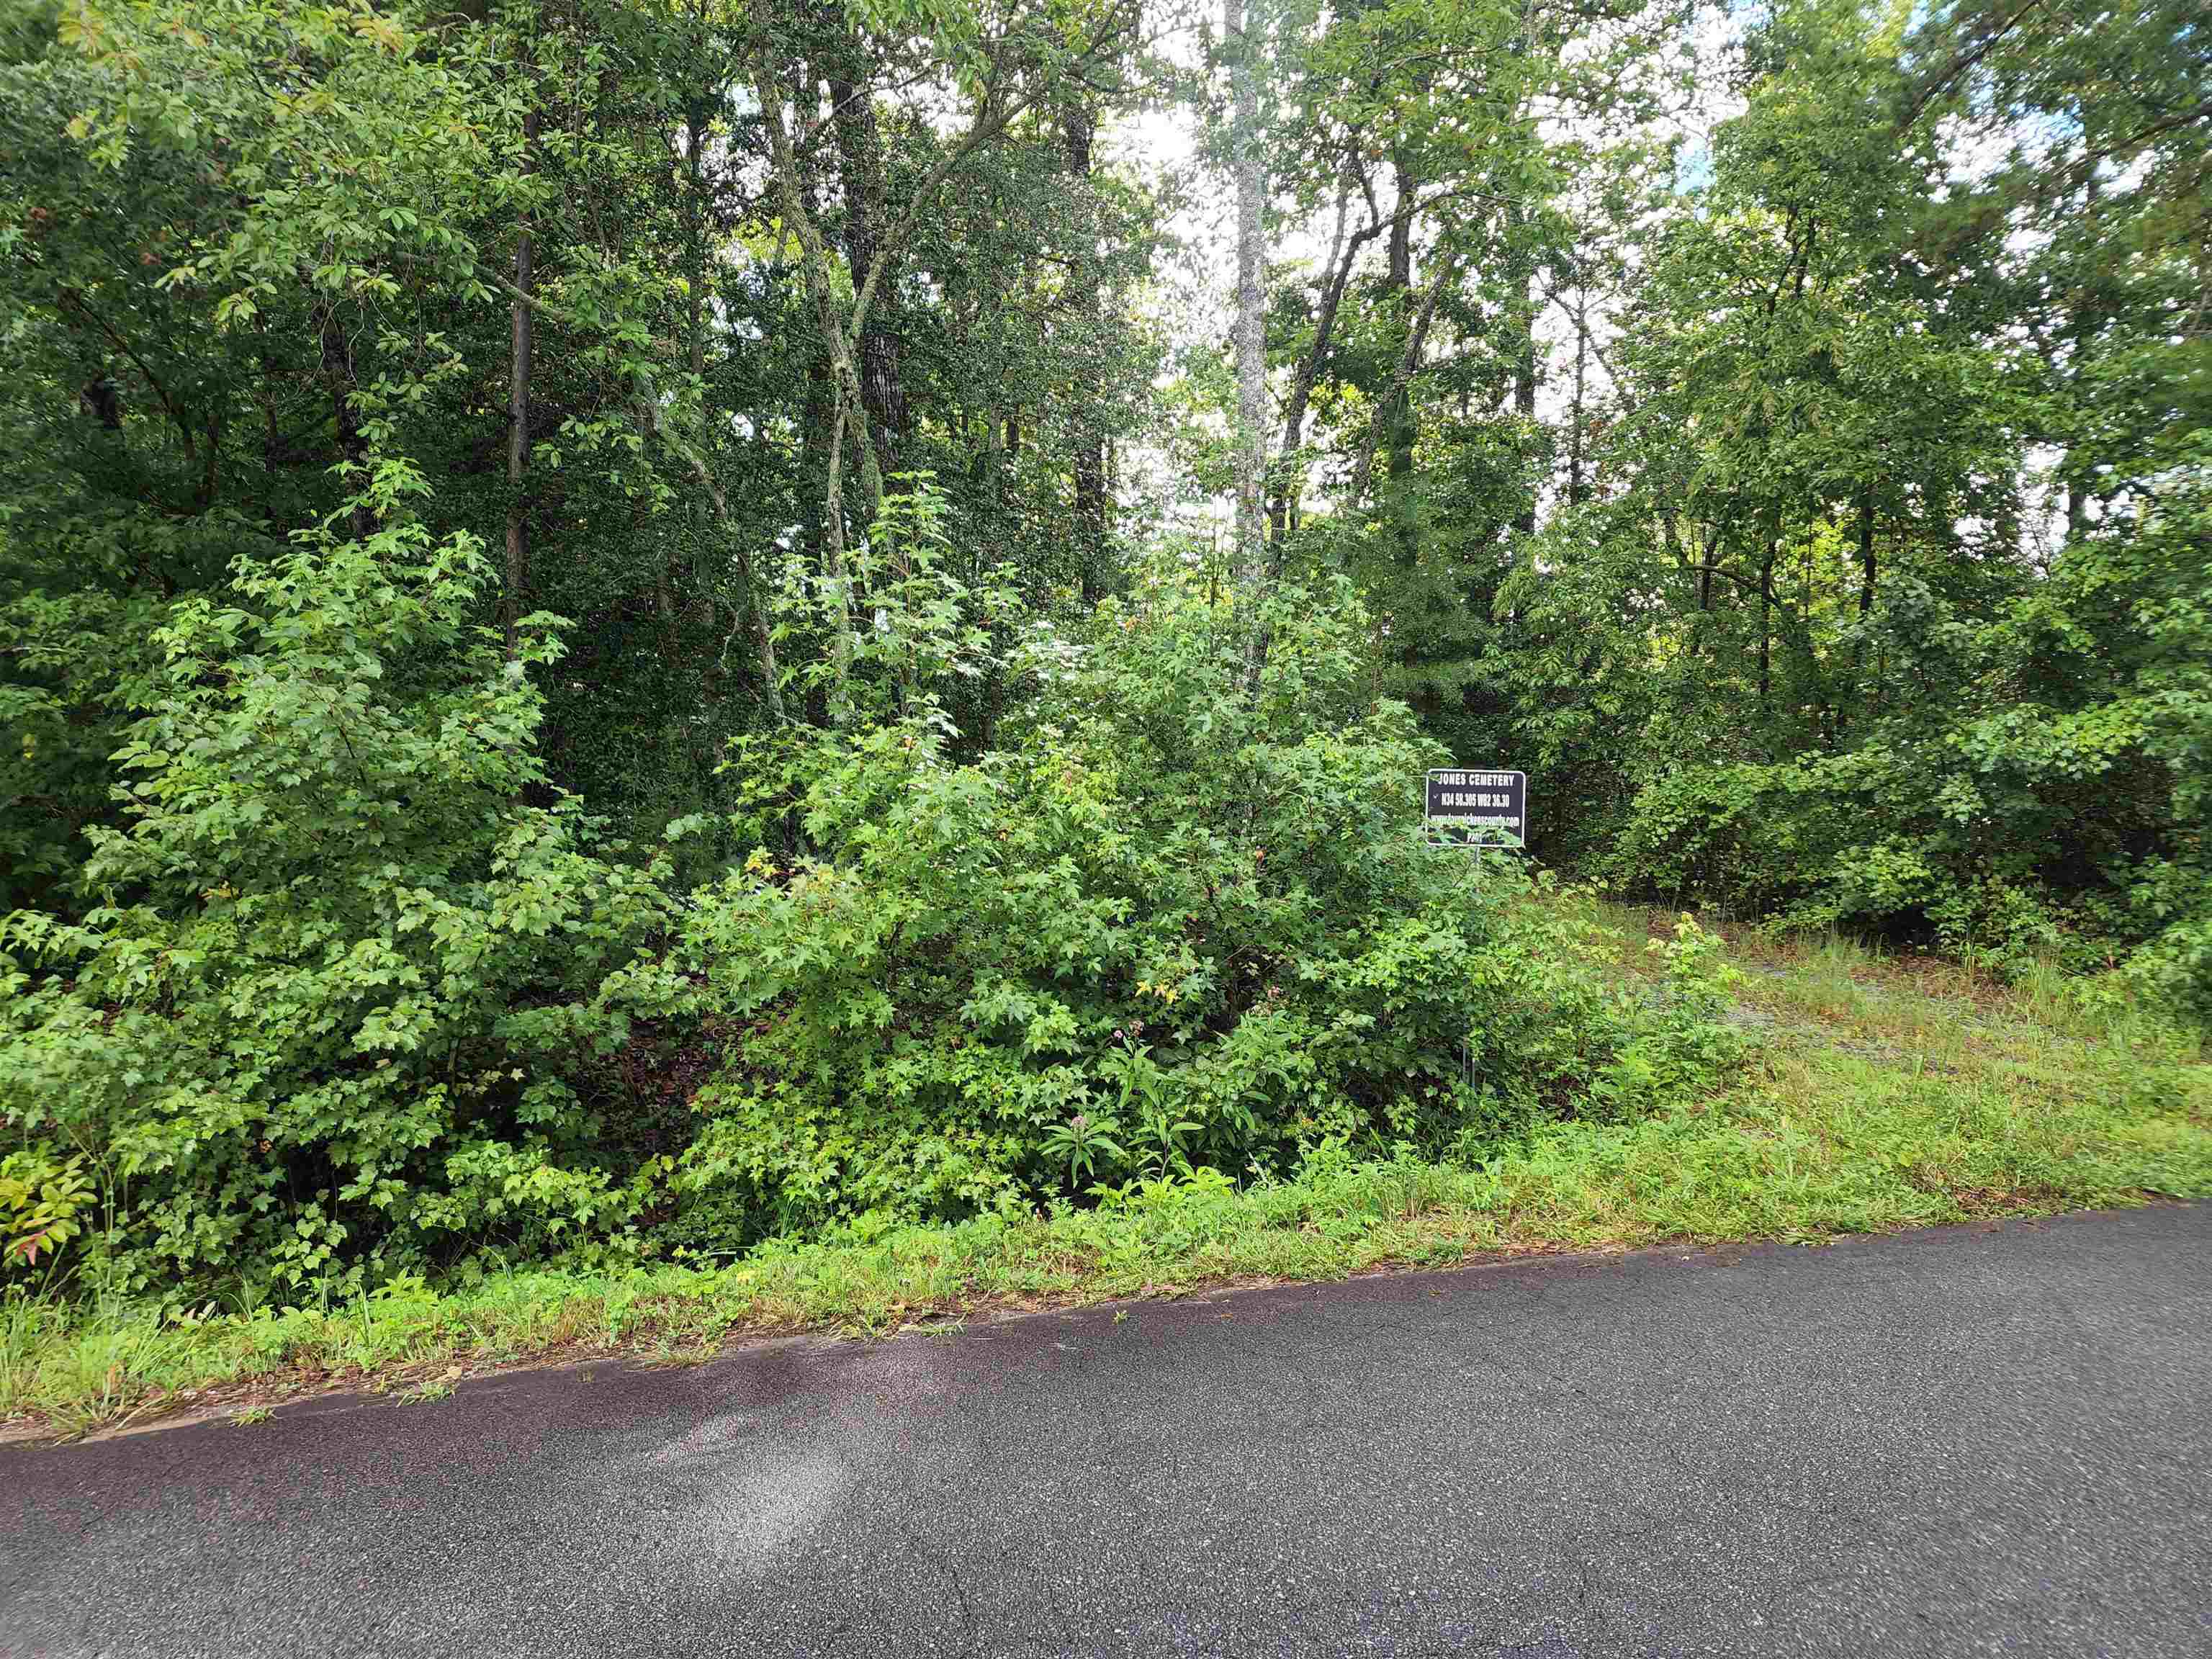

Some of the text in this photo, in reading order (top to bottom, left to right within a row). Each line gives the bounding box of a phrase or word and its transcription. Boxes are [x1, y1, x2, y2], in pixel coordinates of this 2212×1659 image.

[1439, 773, 1515, 786] JONES CEMETERY
[1442, 793, 1454, 806] N34
